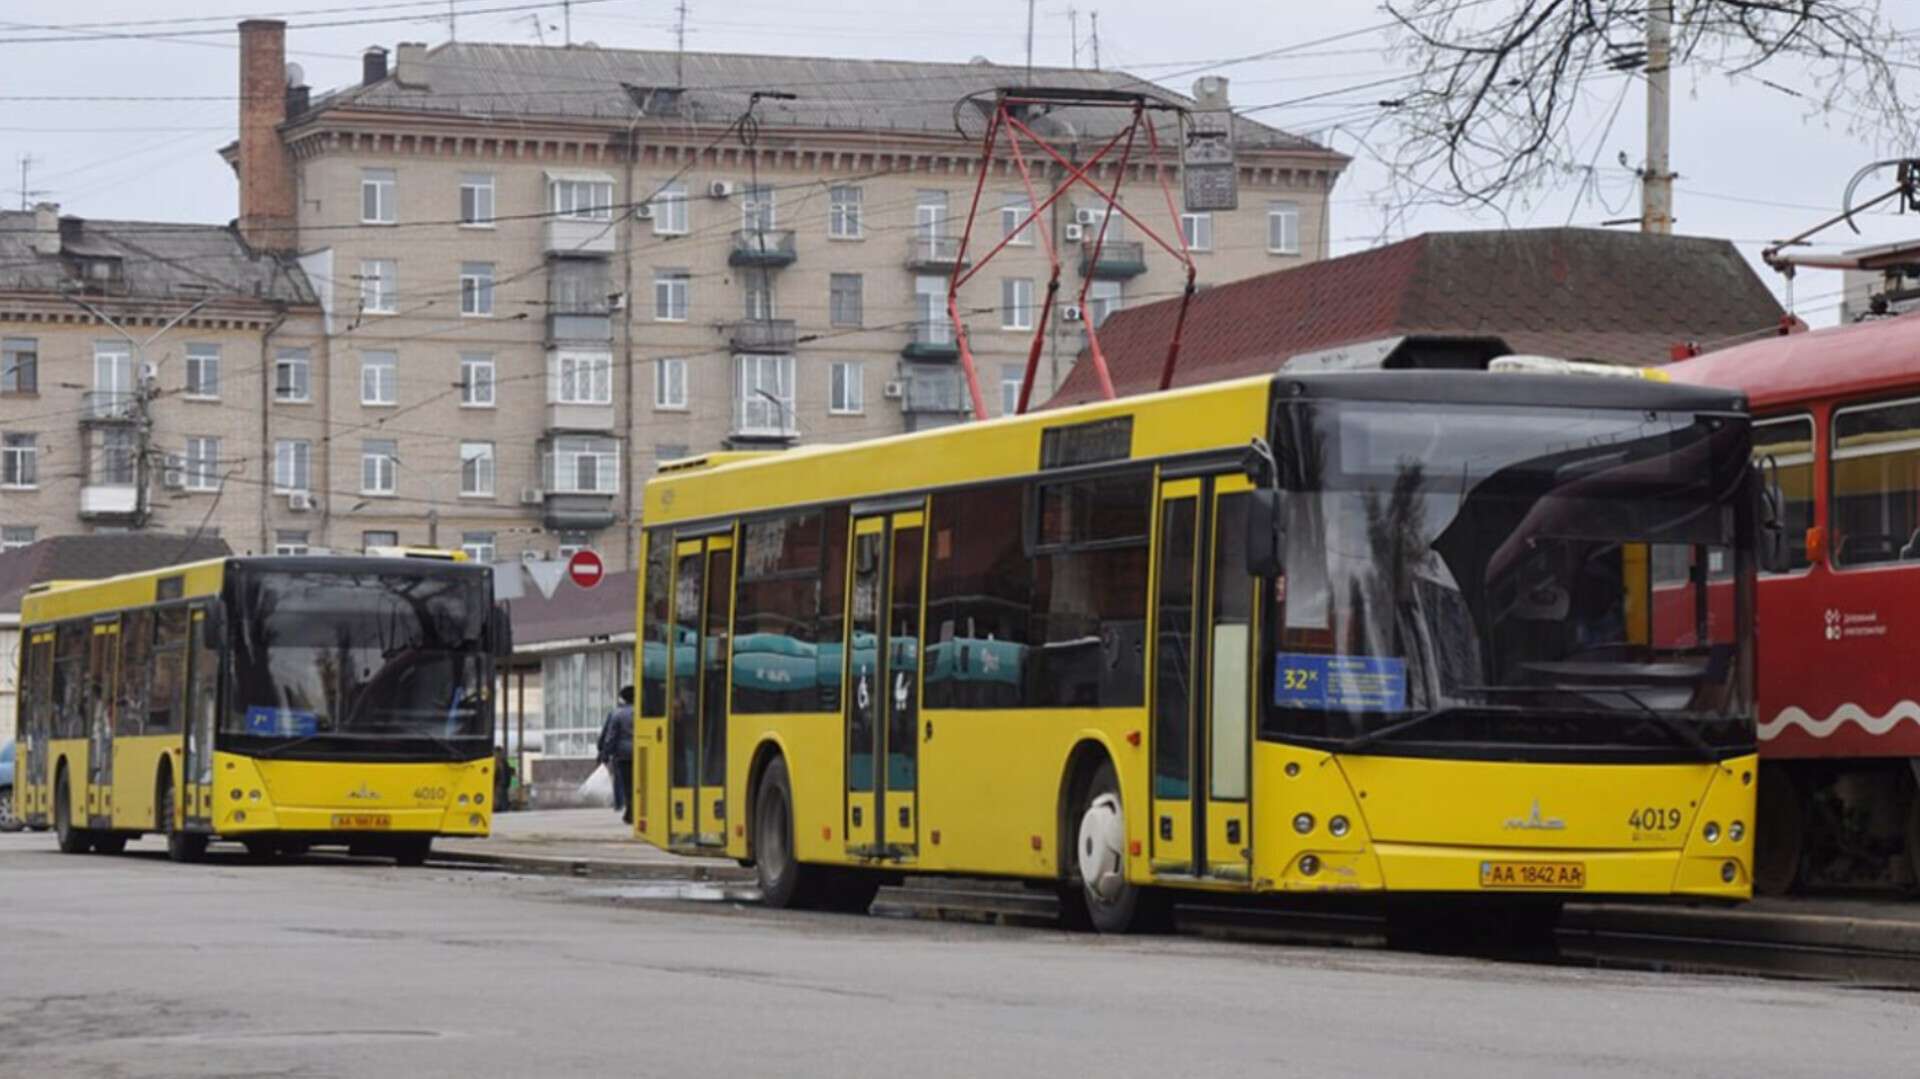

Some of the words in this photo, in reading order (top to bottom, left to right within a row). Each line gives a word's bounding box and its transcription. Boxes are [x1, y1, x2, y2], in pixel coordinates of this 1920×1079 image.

[1628, 807, 1681, 831] 4019
[1492, 864, 1515, 881] AA
[1520, 865, 1554, 882] 1842
